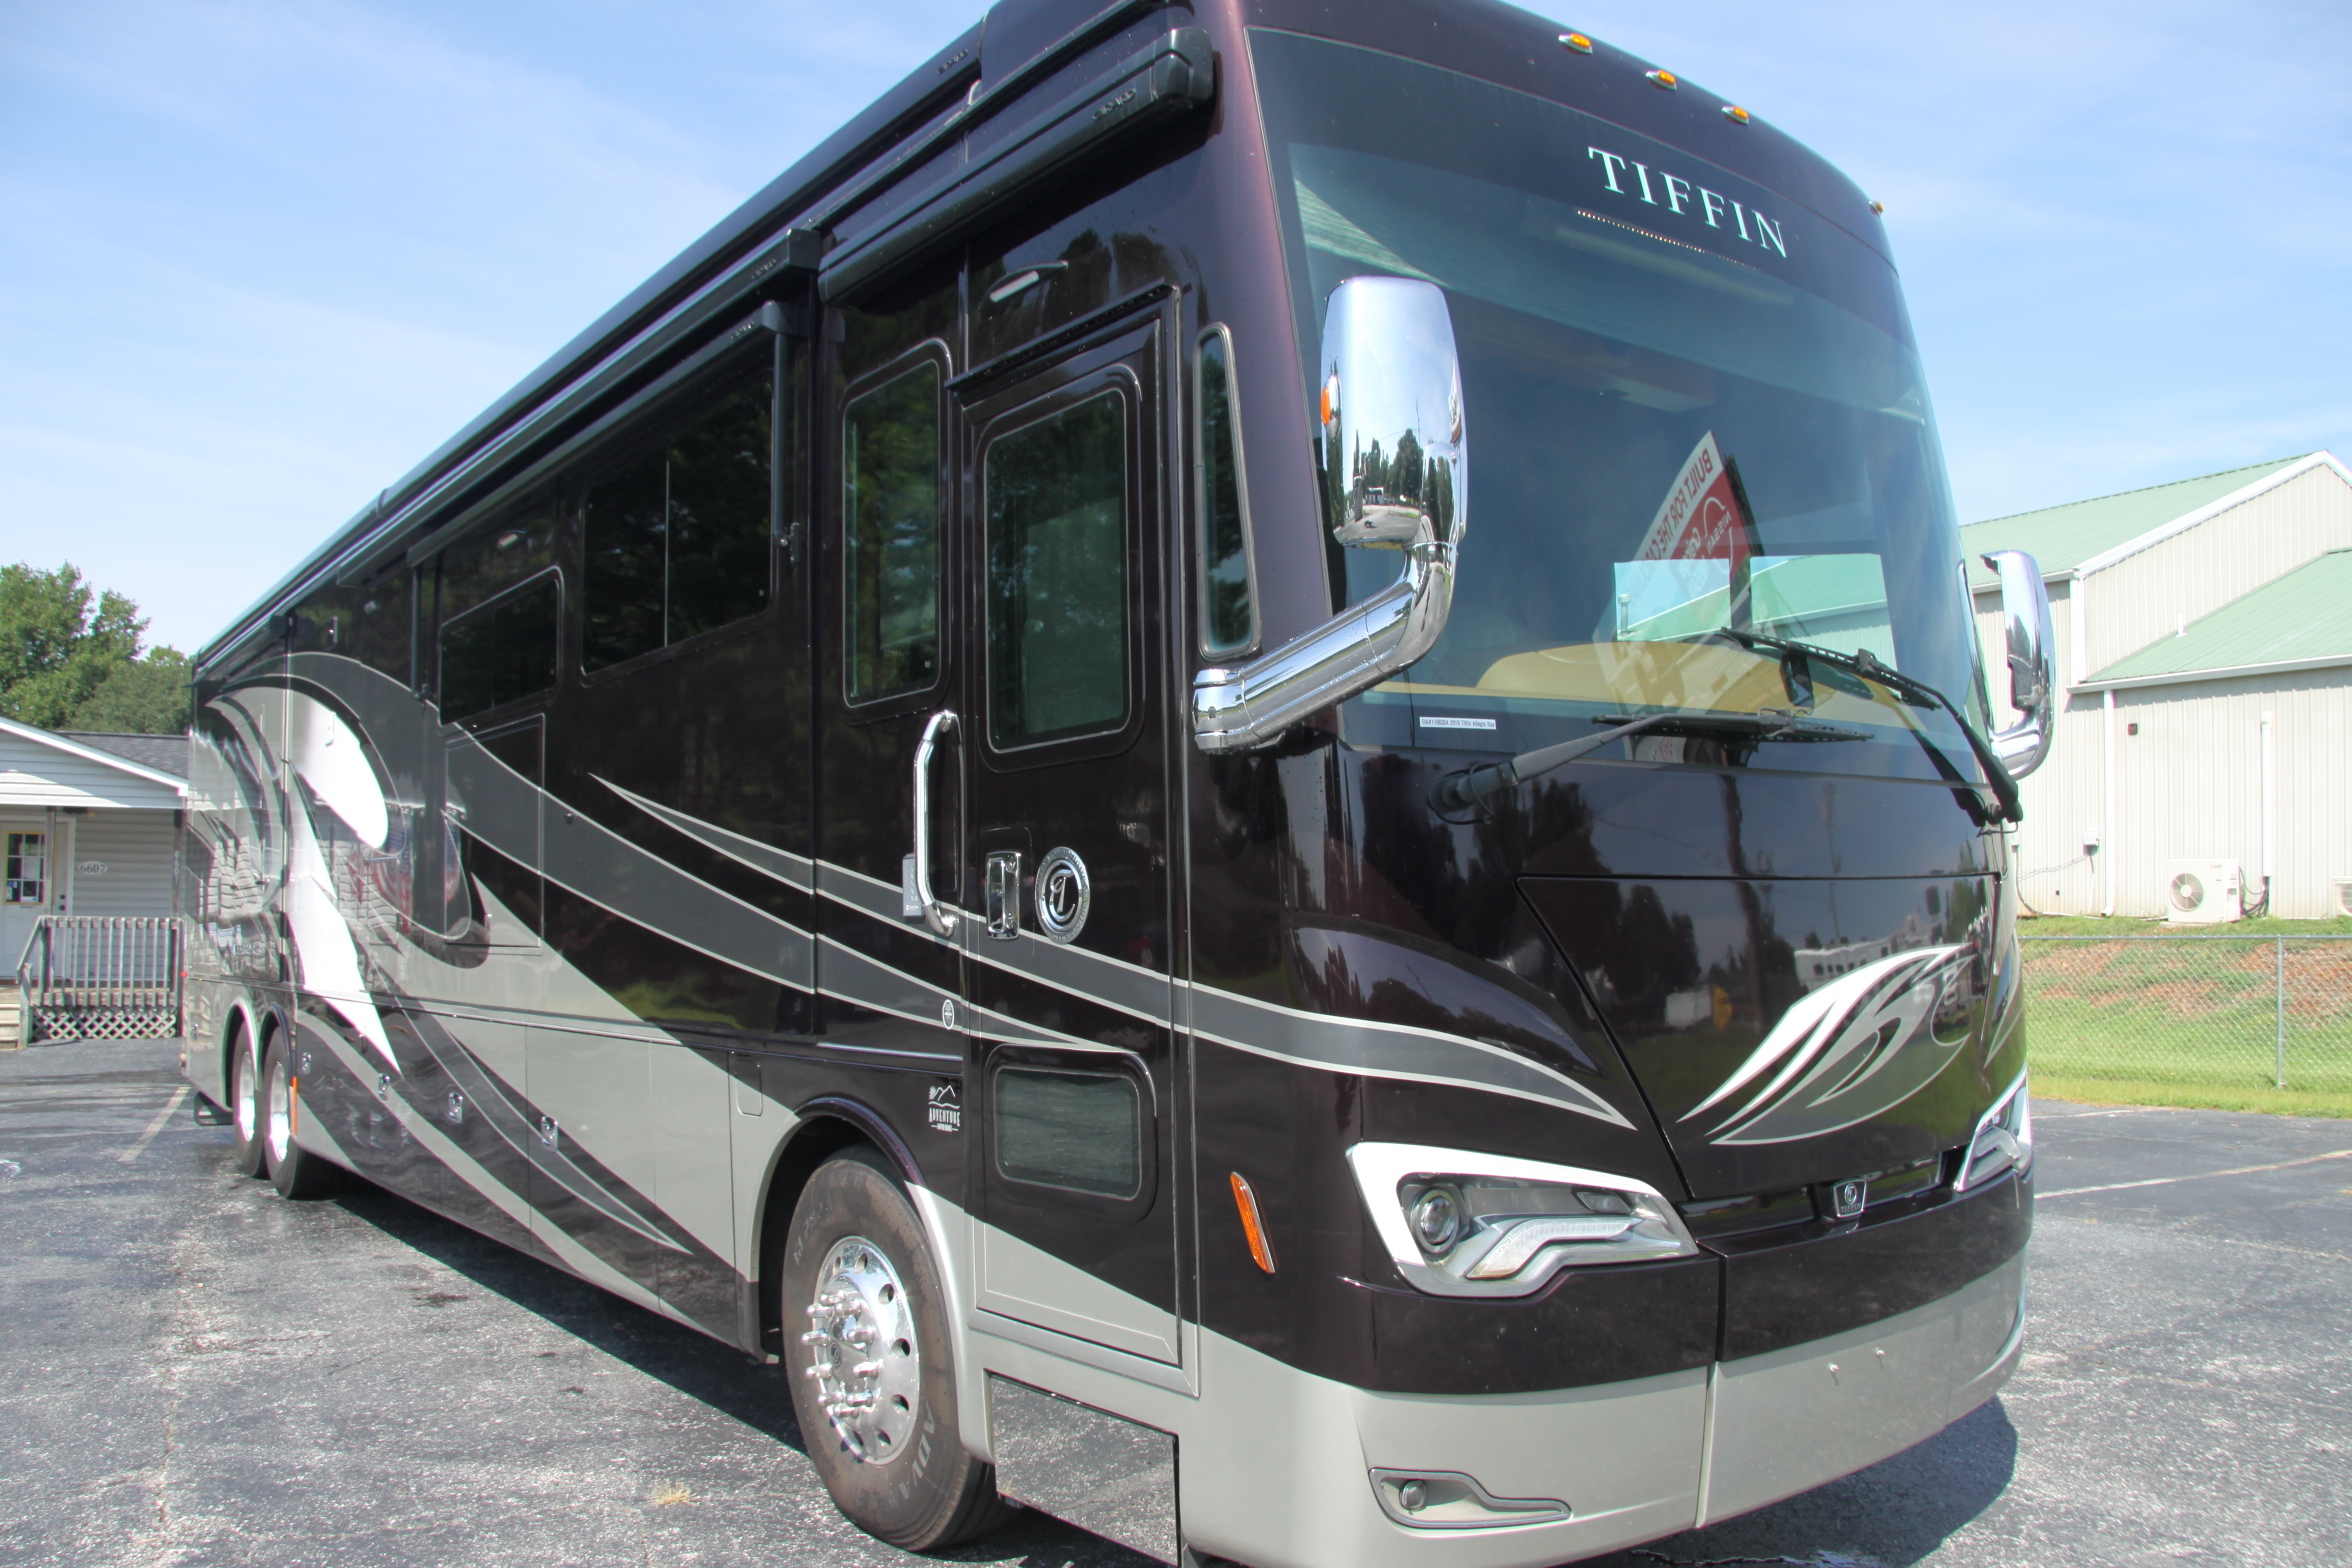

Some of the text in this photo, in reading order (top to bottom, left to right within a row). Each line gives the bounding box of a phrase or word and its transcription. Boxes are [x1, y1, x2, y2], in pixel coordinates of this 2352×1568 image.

[1587, 146, 1787, 258] TIFFIN
[80, 863, 106, 874] 6607
[1840, 1202, 1863, 1214] TIFFIN
